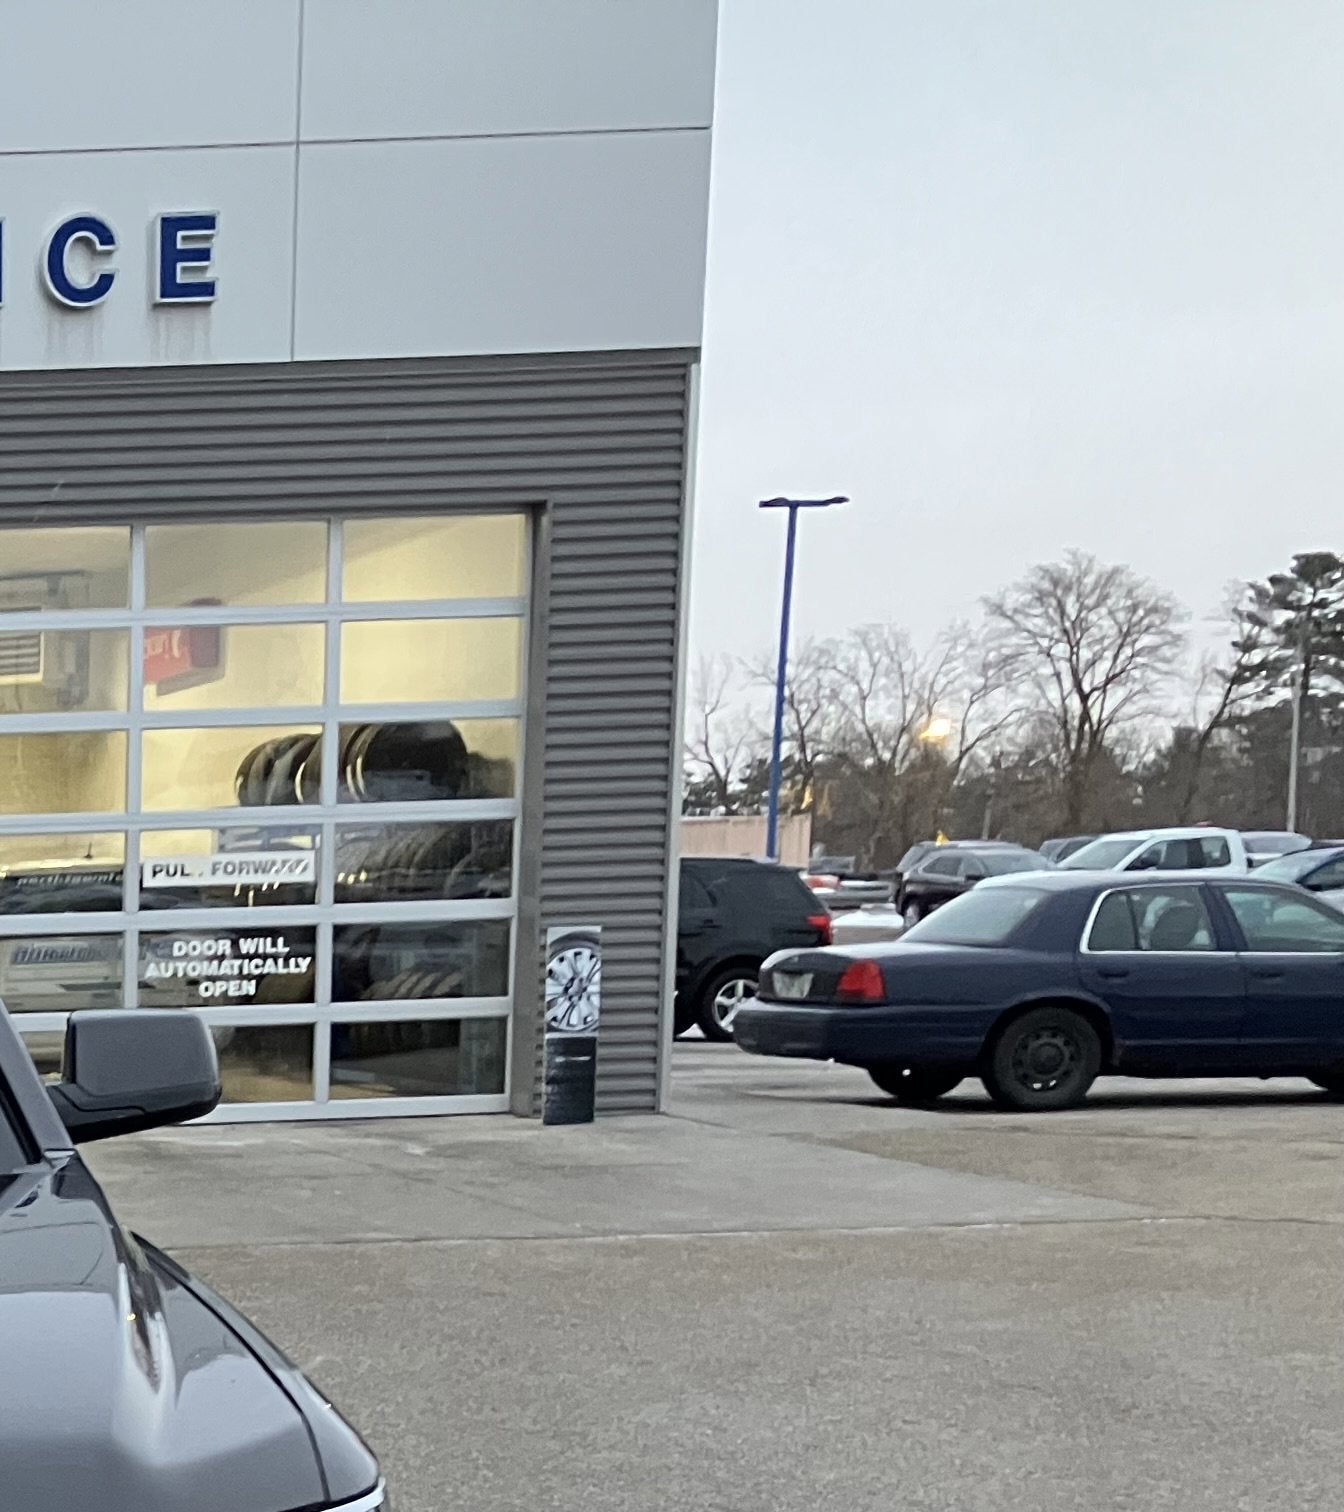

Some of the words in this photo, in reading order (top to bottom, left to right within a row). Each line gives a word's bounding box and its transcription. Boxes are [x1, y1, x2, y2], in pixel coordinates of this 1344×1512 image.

[172, 939, 232, 957] DOOR
[239, 936, 290, 955] WILL
[144, 956, 312, 979] AUTOMATICALLY
[198, 979, 257, 998] OPEN
